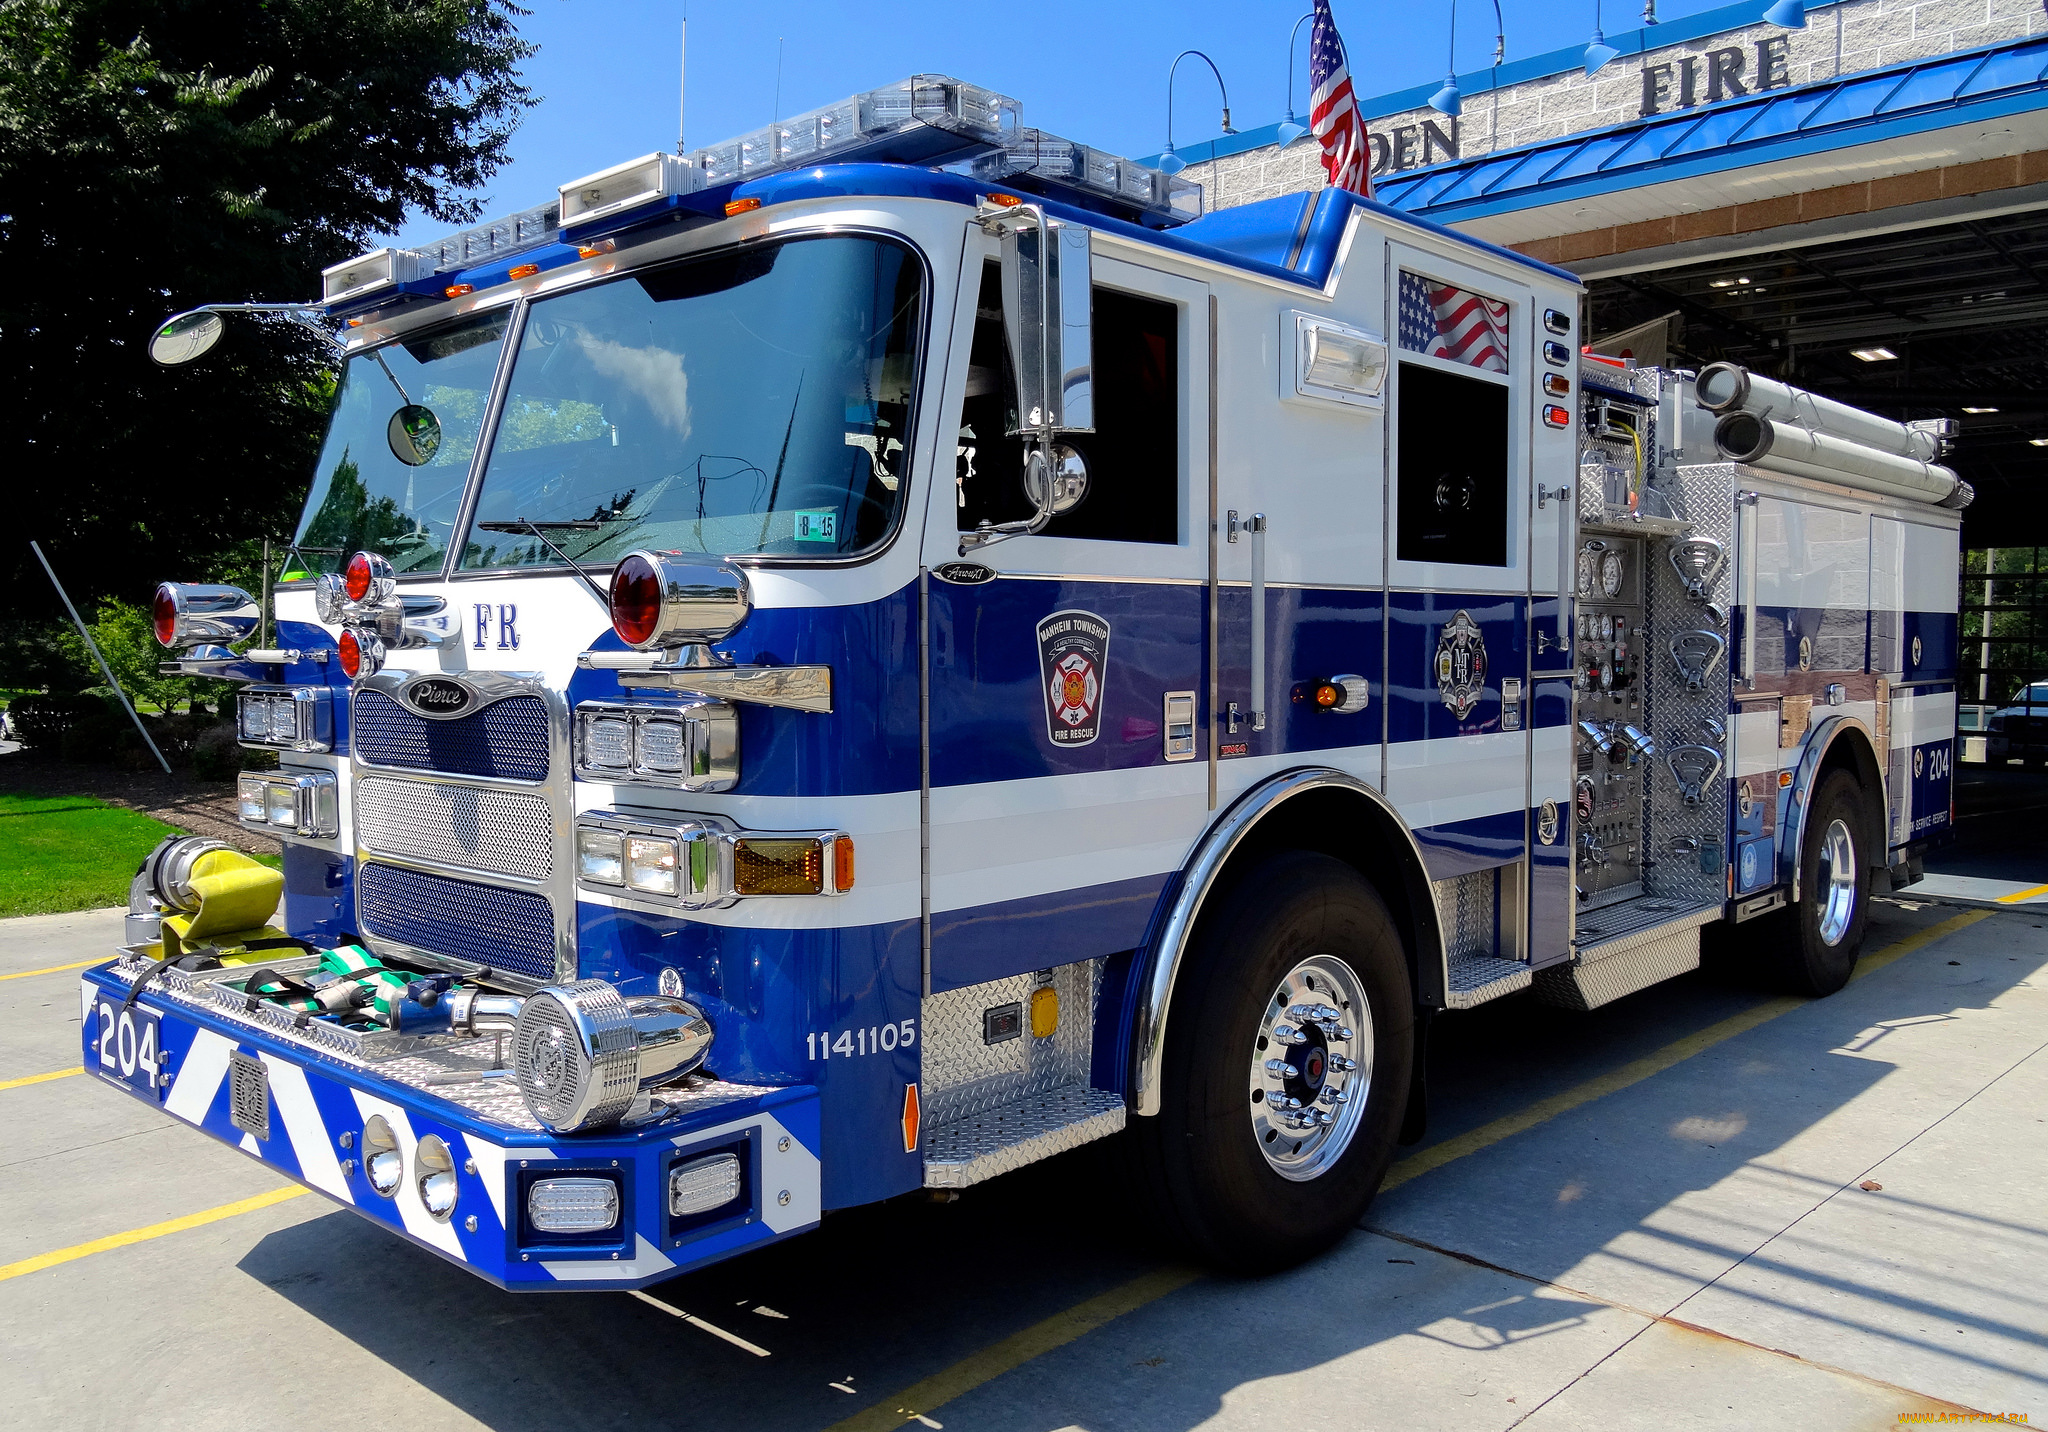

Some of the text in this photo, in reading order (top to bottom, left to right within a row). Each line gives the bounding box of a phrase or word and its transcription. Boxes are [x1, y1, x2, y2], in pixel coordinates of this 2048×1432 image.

[1638, 34, 1789, 116] FIRE
[821, 516, 833, 537] 15
[473, 603, 521, 651] FR
[1040, 619, 1107, 642] MANHEIM TOWNSHIP
[414, 682, 462, 705] Pierce
[1055, 728, 1094, 740] FIRE RESCUE
[1929, 747, 1949, 781] 204
[100, 1002, 158, 1089] 204
[806, 1018, 916, 1061] 1141105
